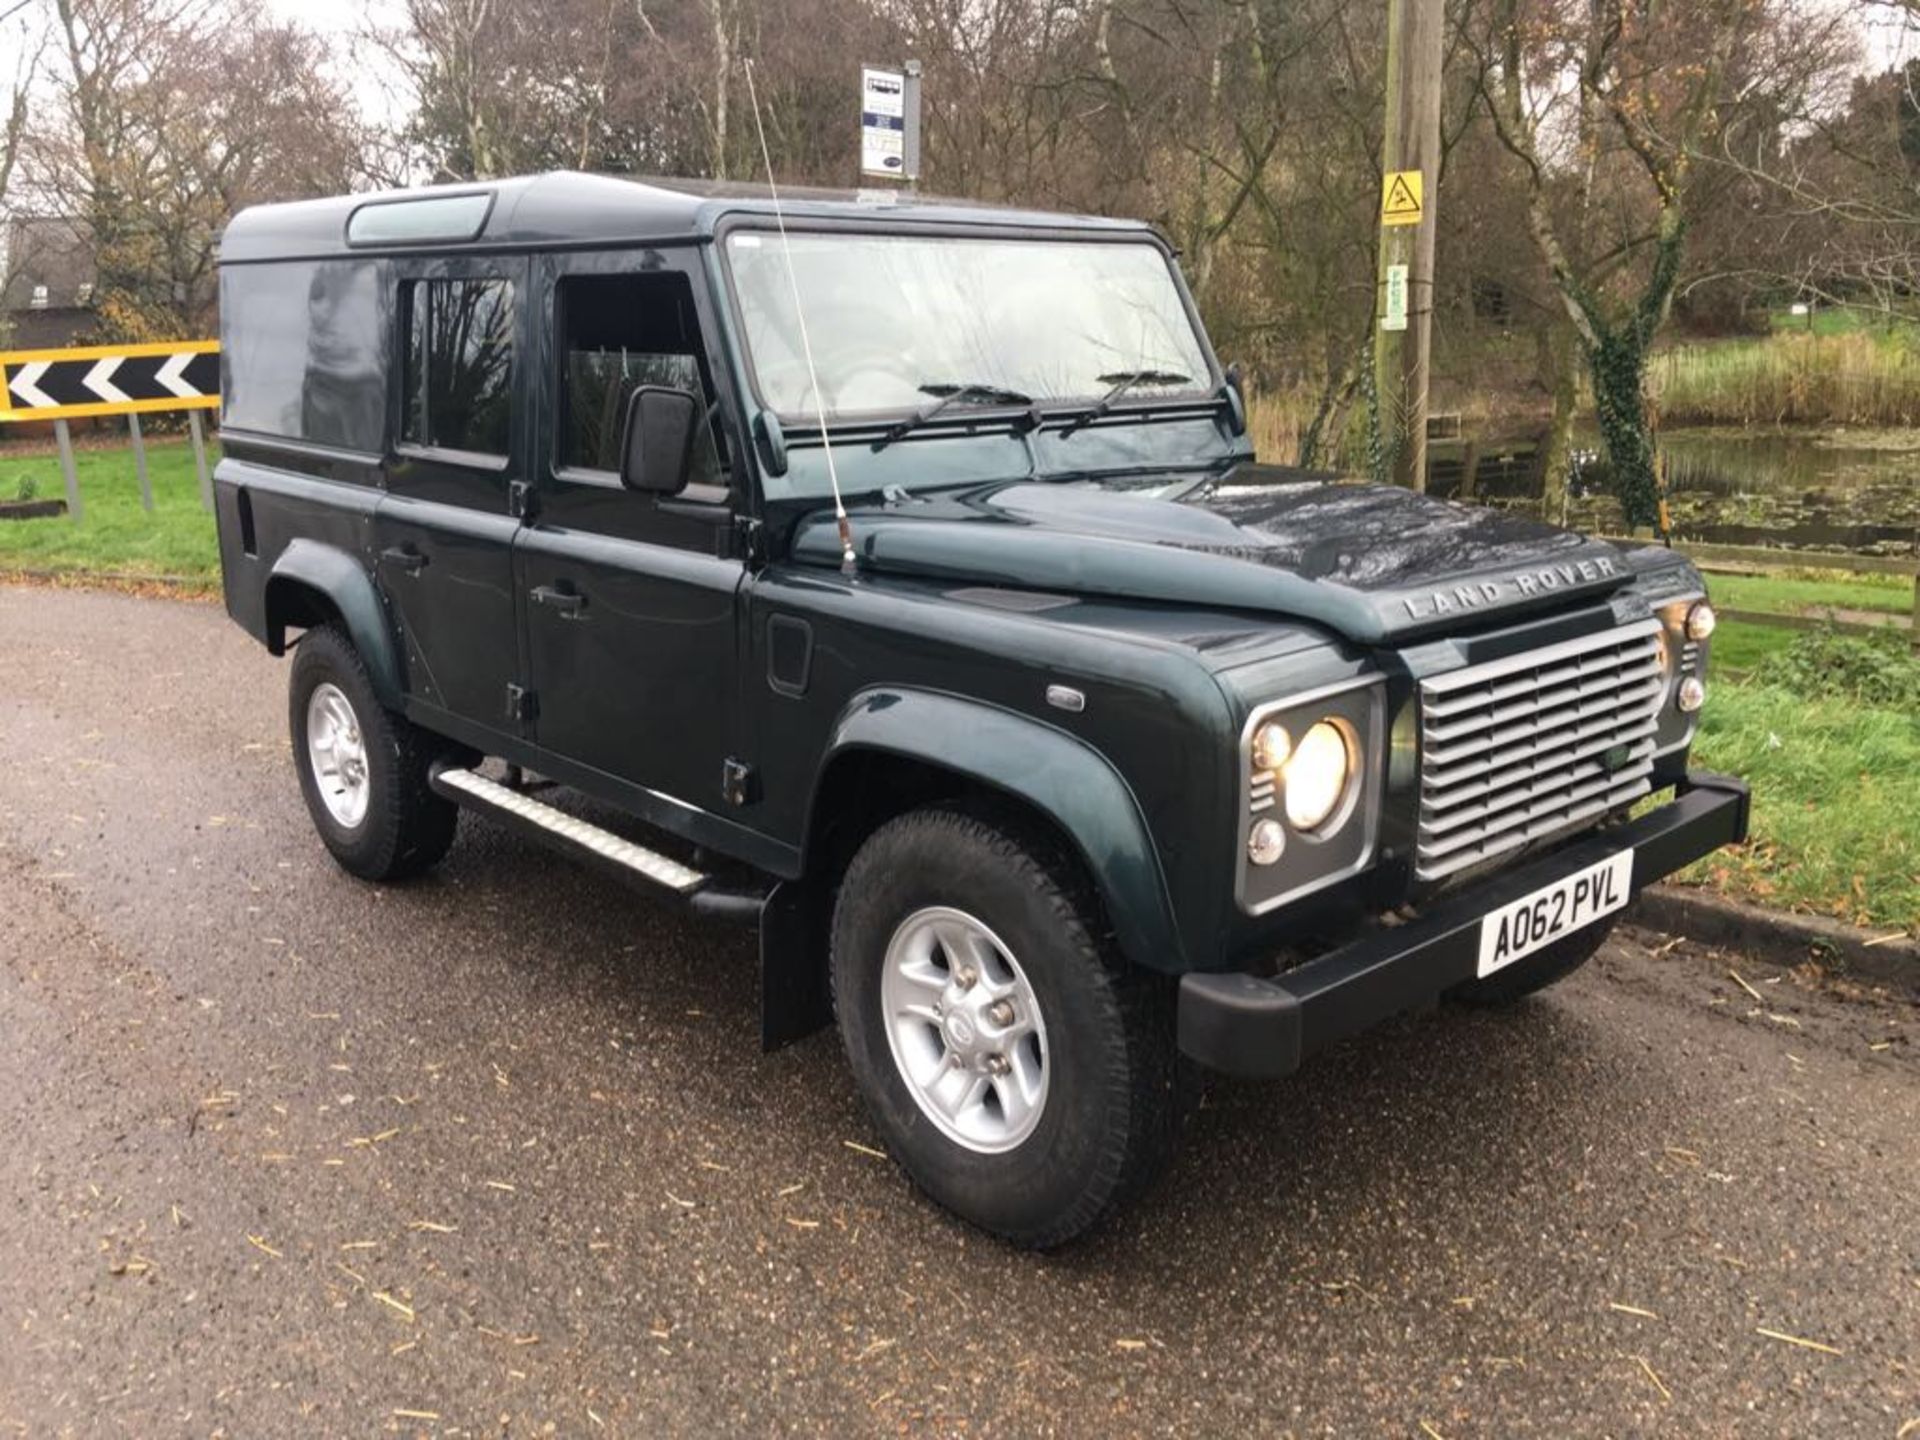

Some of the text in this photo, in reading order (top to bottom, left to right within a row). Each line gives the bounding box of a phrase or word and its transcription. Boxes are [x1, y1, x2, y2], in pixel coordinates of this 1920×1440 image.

[1403, 557, 1616, 620] LAND ROVER
[1572, 865, 1618, 922] PVL
